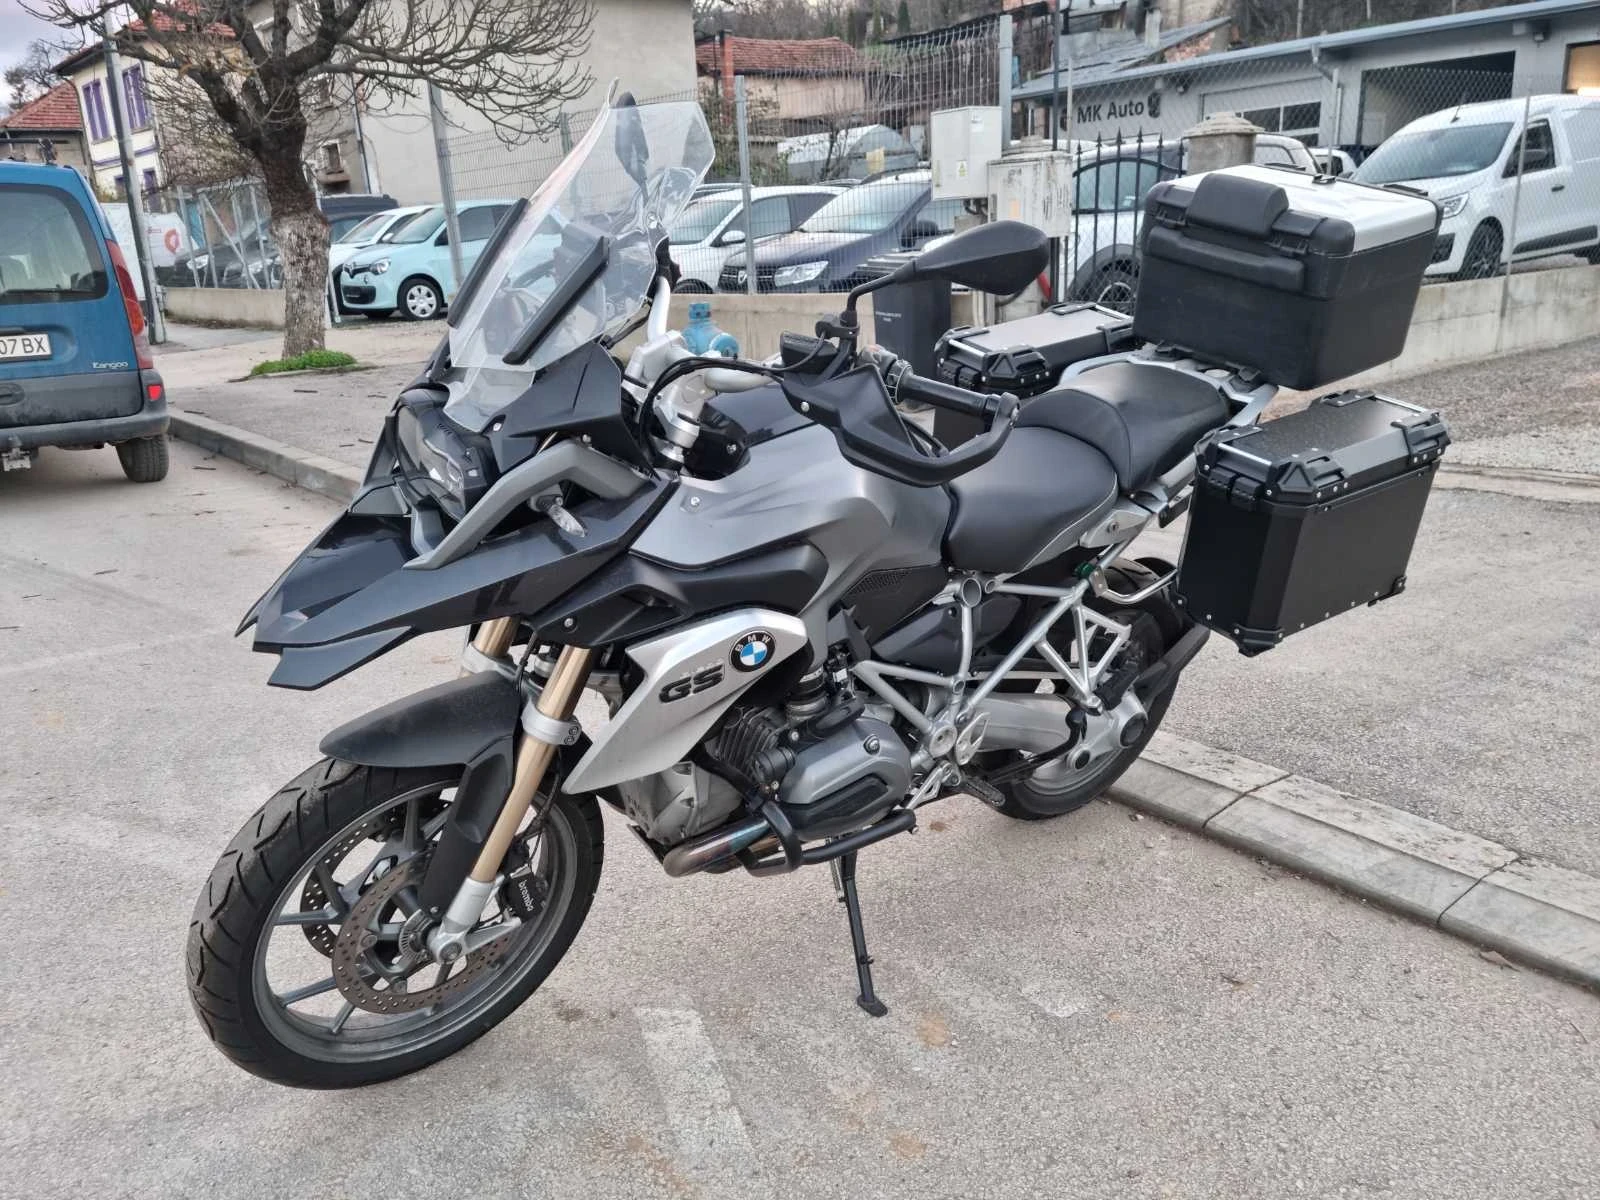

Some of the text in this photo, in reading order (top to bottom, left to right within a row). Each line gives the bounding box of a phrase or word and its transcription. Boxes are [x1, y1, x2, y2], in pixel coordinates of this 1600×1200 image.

[1077, 100, 1144, 124] MK Auto
[22, 337, 47, 353] BX
[92, 360, 129, 370] Kangoo
[735, 633, 771, 652] BMW
[659, 664, 725, 703] GS
[518, 879, 535, 912] brembo
